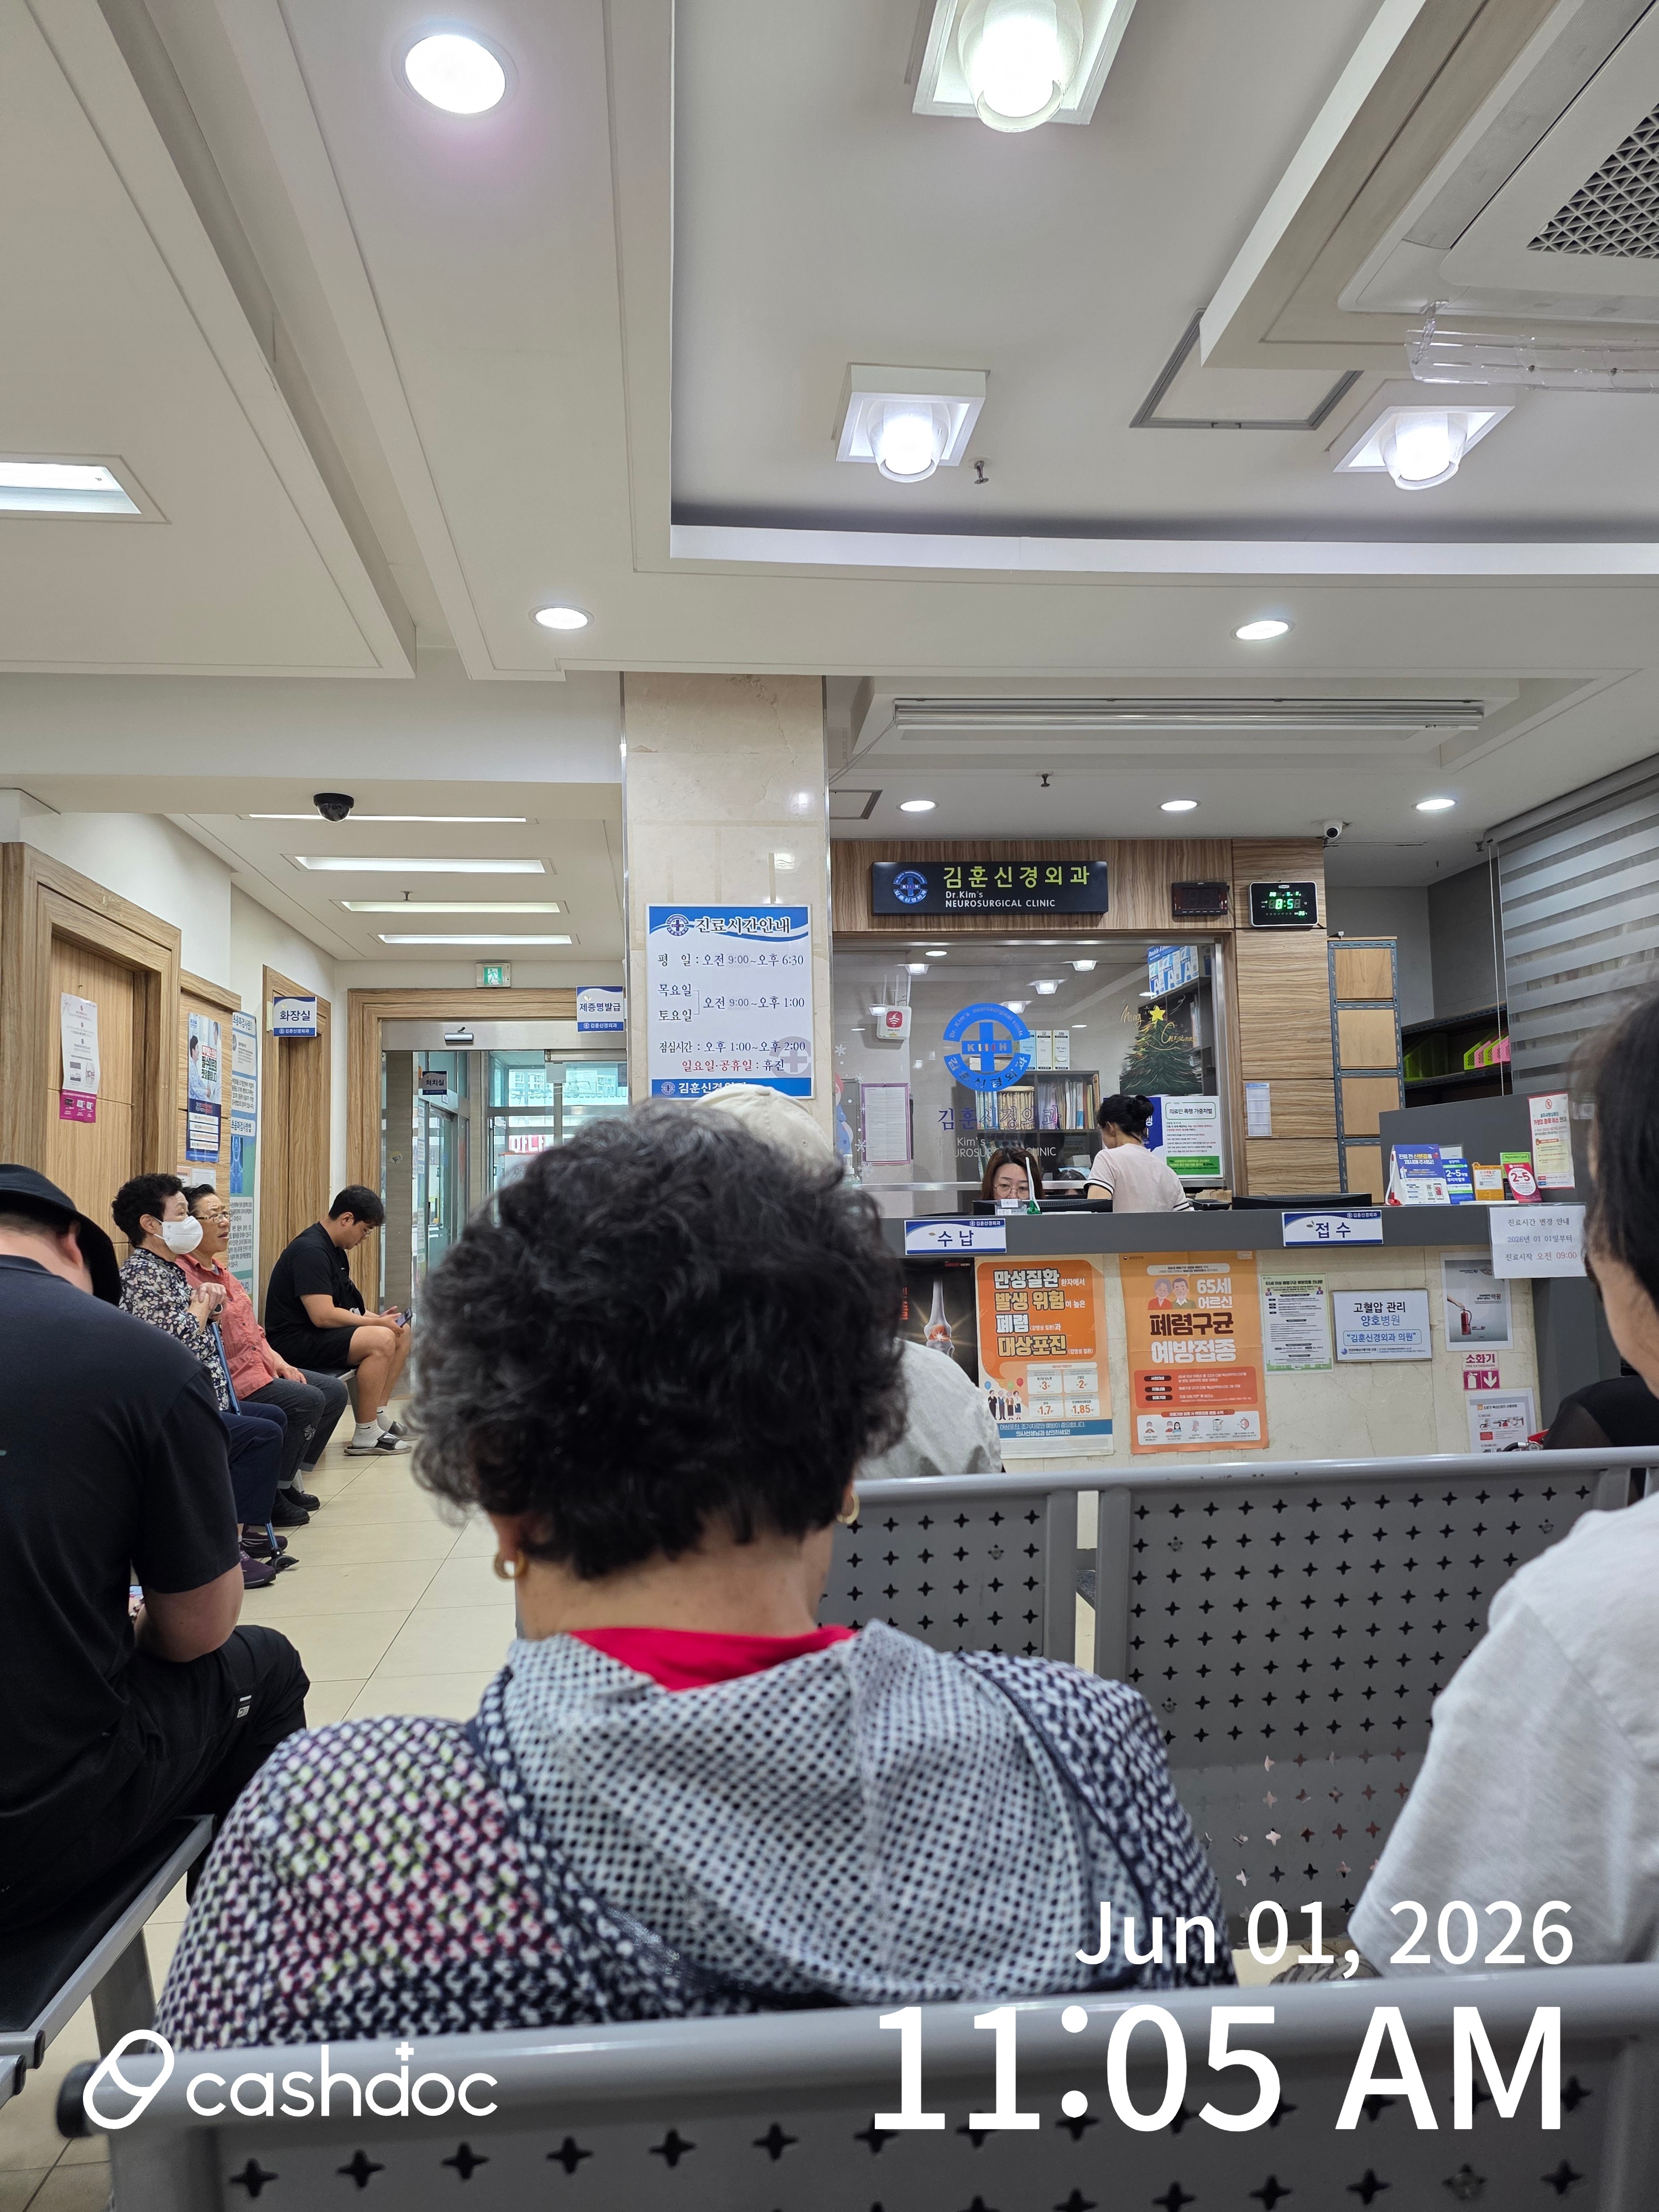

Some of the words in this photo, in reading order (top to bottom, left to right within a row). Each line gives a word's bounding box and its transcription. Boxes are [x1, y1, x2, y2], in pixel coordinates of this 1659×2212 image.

[943, 865, 1090, 888] 김훈신경외과
[945, 899, 1022, 908] NEUROSURGICAL
[1026, 899, 1056, 907] CLINIC
[695, 917, 791, 933] 진료시간안내
[702, 954, 724, 967] 오전
[782, 954, 804, 966] 6:30
[658, 984, 692, 997] 목요일
[579, 1003, 621, 1012] 제증명발급
[703, 997, 725, 1010] 오전
[784, 998, 805, 1008] 1:00
[279, 1010, 311, 1021] 화장실
[658, 1009, 692, 1022] 토요일
[659, 1041, 693, 1053] 점심시간
[703, 1041, 726, 1053] 오후
[784, 1042, 806, 1051] 2:00
[762, 1060, 784, 1072] 휴진
[937, 1105, 1062, 1130] 김훈신경외과
[1507, 1218, 1536, 1227] 진료시간
[1536, 1252, 1552, 1261] 오전
[994, 1268, 1061, 1290] 만성질환
[1061, 1278, 1086, 1287] 환자에서
[1197, 1277, 1232, 1295] 65세
[995, 1291, 1029, 1311] 발생
[1073, 1300, 1086, 1308] 높은
[1198, 1296, 1233, 1310] 어르신
[1353, 1302, 1383, 1313] 고혈압
[1386, 1301, 1406, 1313] 관리
[1149, 1312, 1234, 1336] 폐렴구균
[1361, 1314, 1400, 1327] 양호병원
[997, 1334, 1067, 1357] 대상포진
[1151, 1339, 1237, 1364] 예방접종
[1465, 1353, 1495, 1364] 소화기
